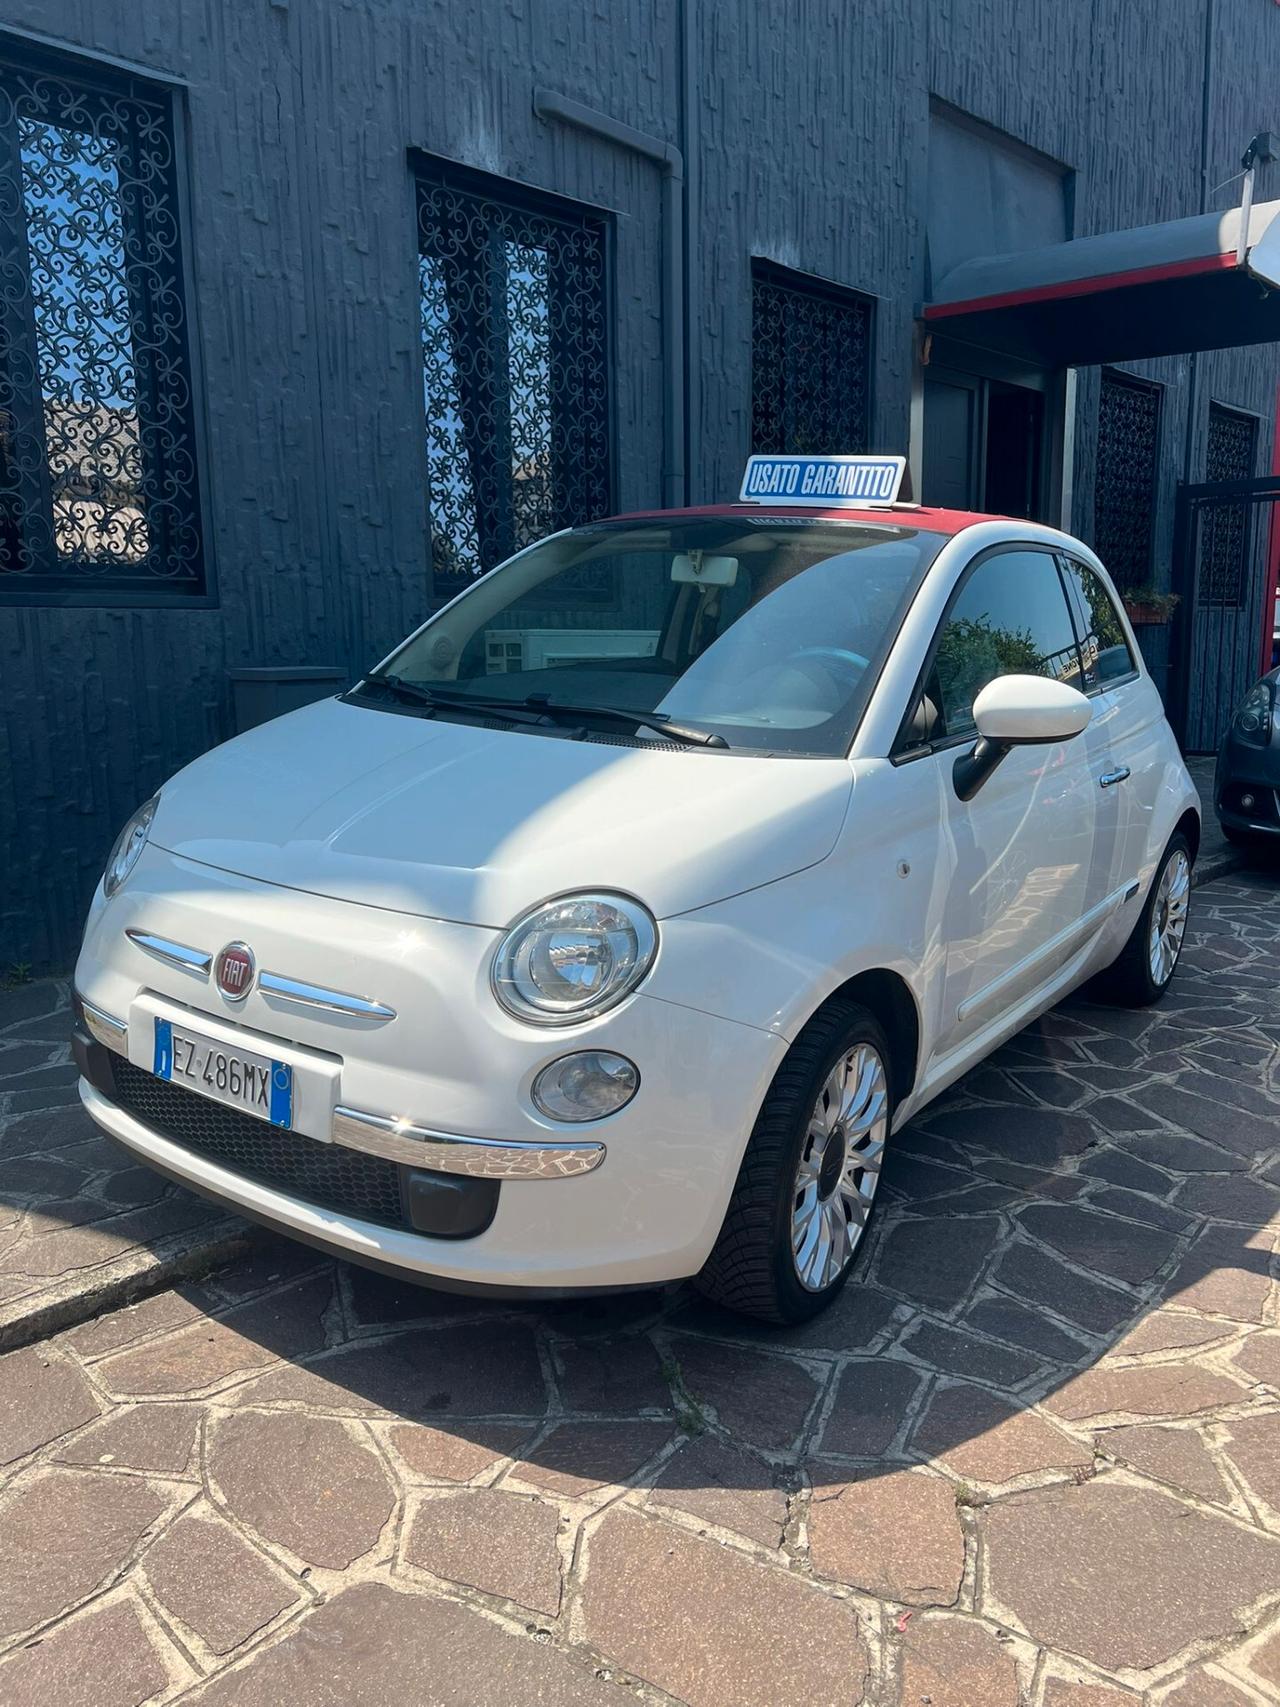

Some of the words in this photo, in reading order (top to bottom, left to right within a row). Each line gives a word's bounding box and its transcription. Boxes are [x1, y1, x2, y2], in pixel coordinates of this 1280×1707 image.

[750, 463, 800, 494] USATO
[801, 464, 896, 497] GARANTITO
[223, 958, 248, 987] FIAT
